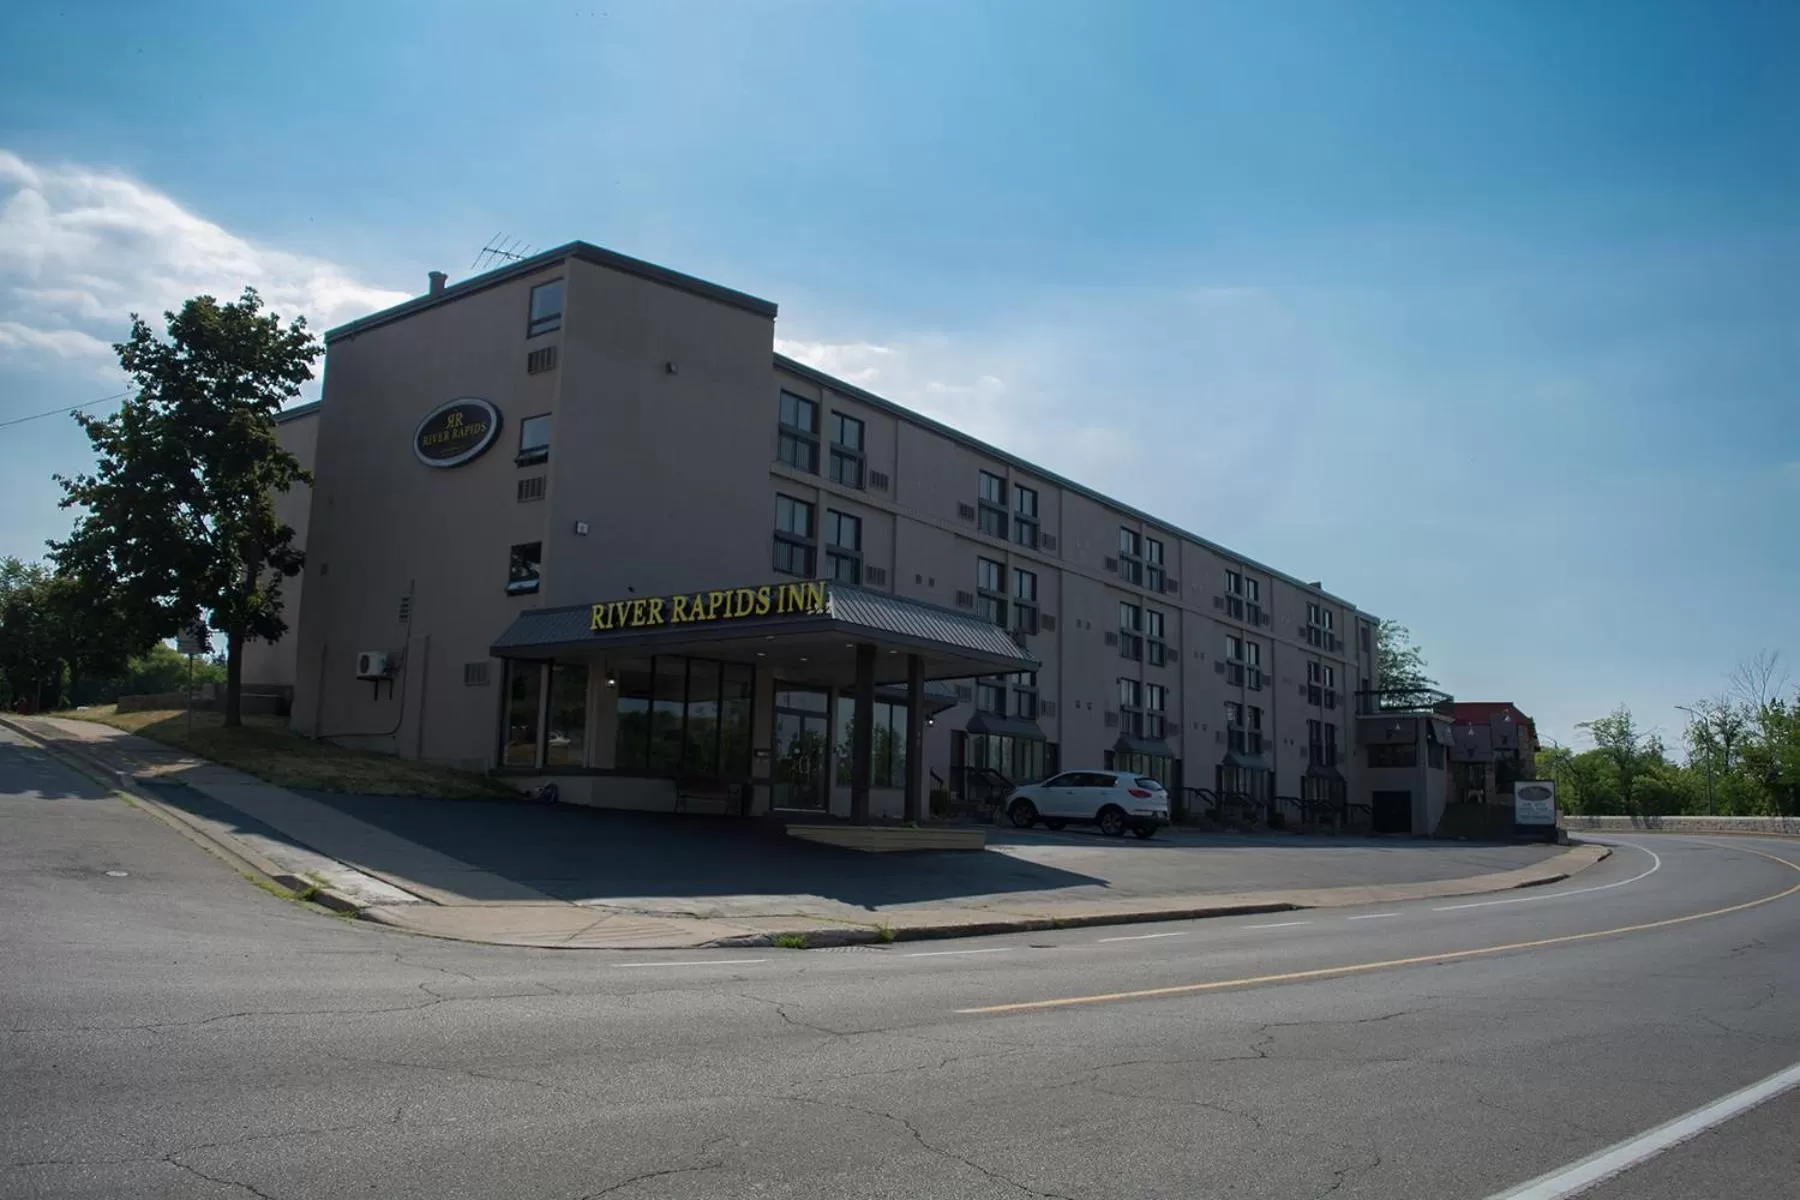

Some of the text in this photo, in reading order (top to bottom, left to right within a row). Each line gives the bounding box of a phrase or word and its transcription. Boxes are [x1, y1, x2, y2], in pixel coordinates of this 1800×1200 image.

[422, 422, 487, 446] RIVER RAPIDS
[590, 581, 827, 630] RIVER RAPIDS INN
